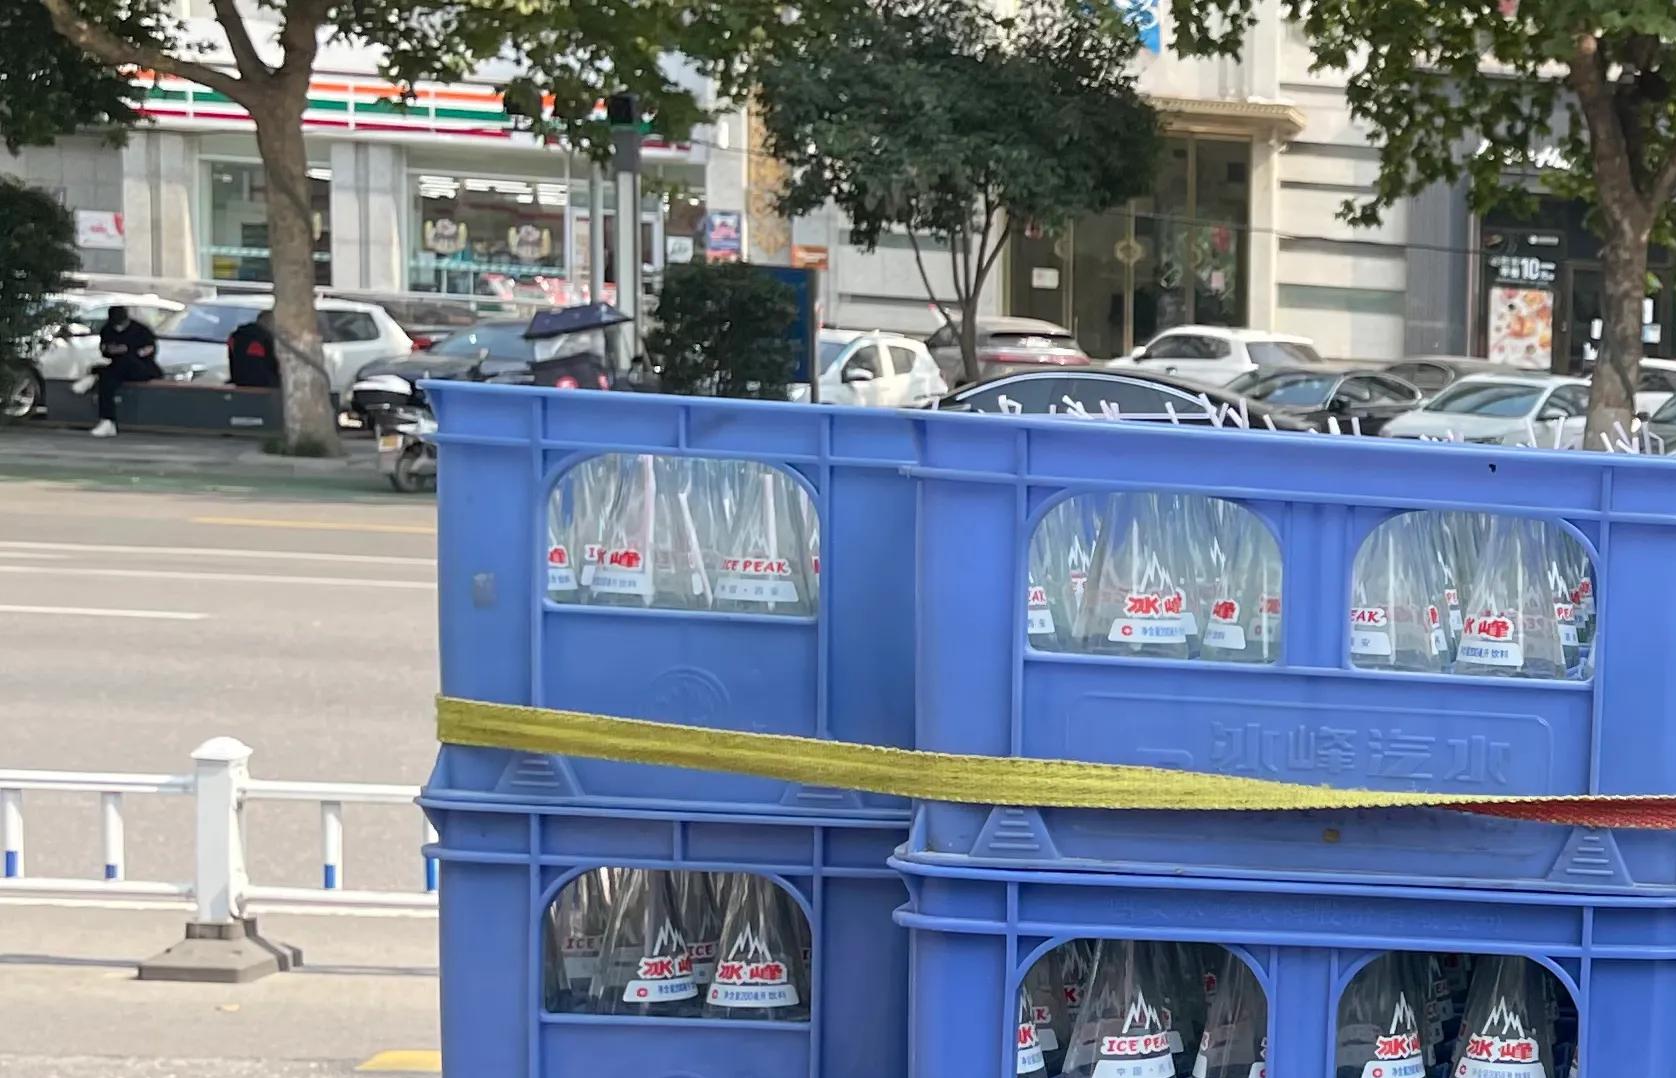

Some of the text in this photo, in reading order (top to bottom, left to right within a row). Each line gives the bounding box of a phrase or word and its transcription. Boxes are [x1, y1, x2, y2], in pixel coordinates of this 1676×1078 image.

[742, 560, 787, 575] PEAK
[1211, 720, 1511, 783] 冰峰汽水
[719, 964, 783, 981] 冰峰
[1107, 1036, 1168, 1053] ICE PEA
[1467, 1039, 1533, 1060] 冰峰
